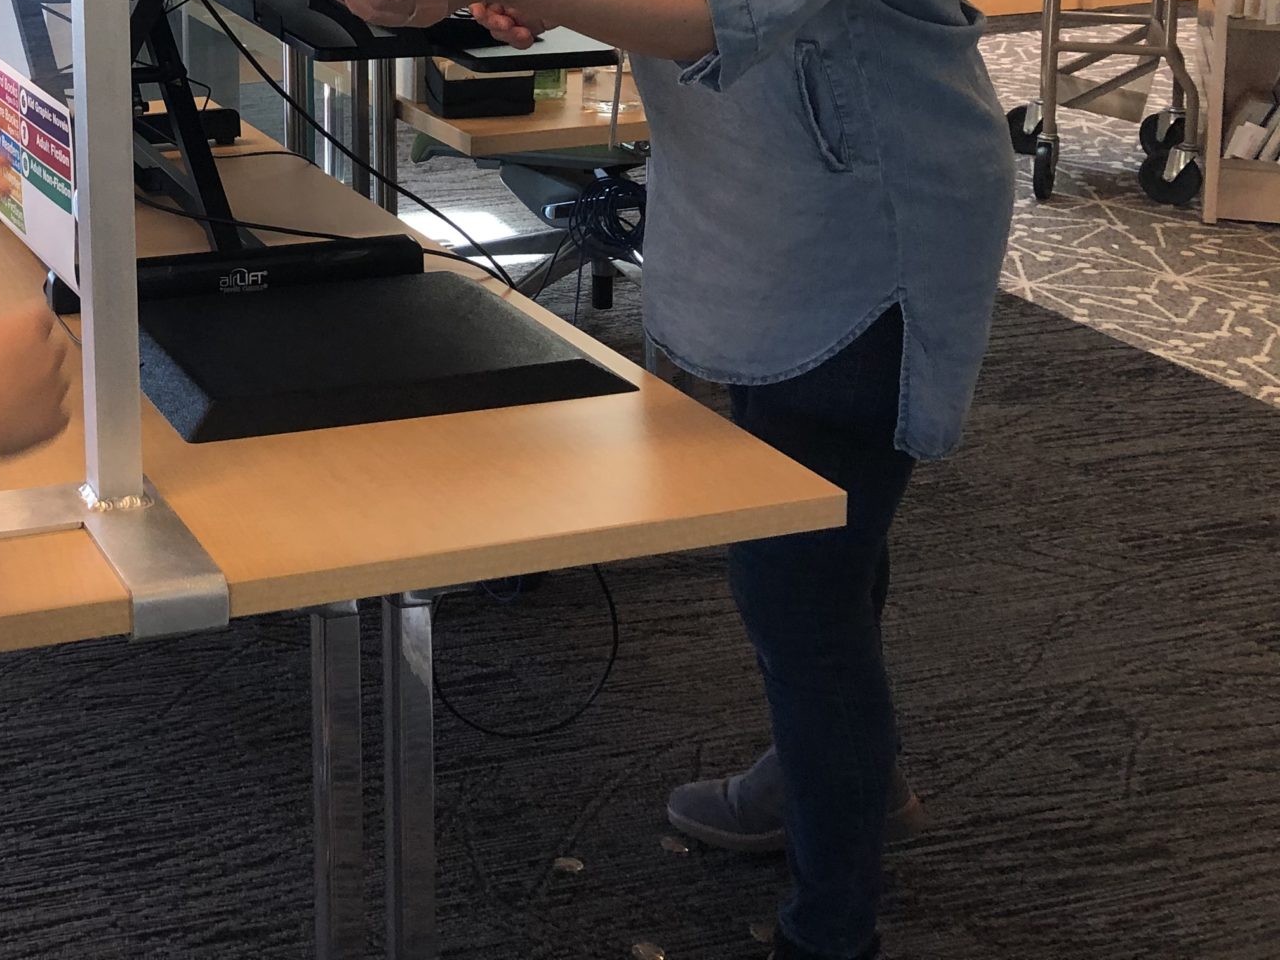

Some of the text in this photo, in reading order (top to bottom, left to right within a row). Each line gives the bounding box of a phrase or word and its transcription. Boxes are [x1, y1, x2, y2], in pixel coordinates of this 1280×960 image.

[5, 78, 19, 98] Books
[5, 107, 19, 130] Books
[27, 95, 35, 111] Kid
[34, 101, 53, 123] Graphic
[52, 112, 70, 134] Novels
[35, 133, 51, 155] Adult
[50, 143, 70, 168] Fiction
[30, 158, 43, 178] Adult
[42, 167, 72, 200] Non-Fiction
